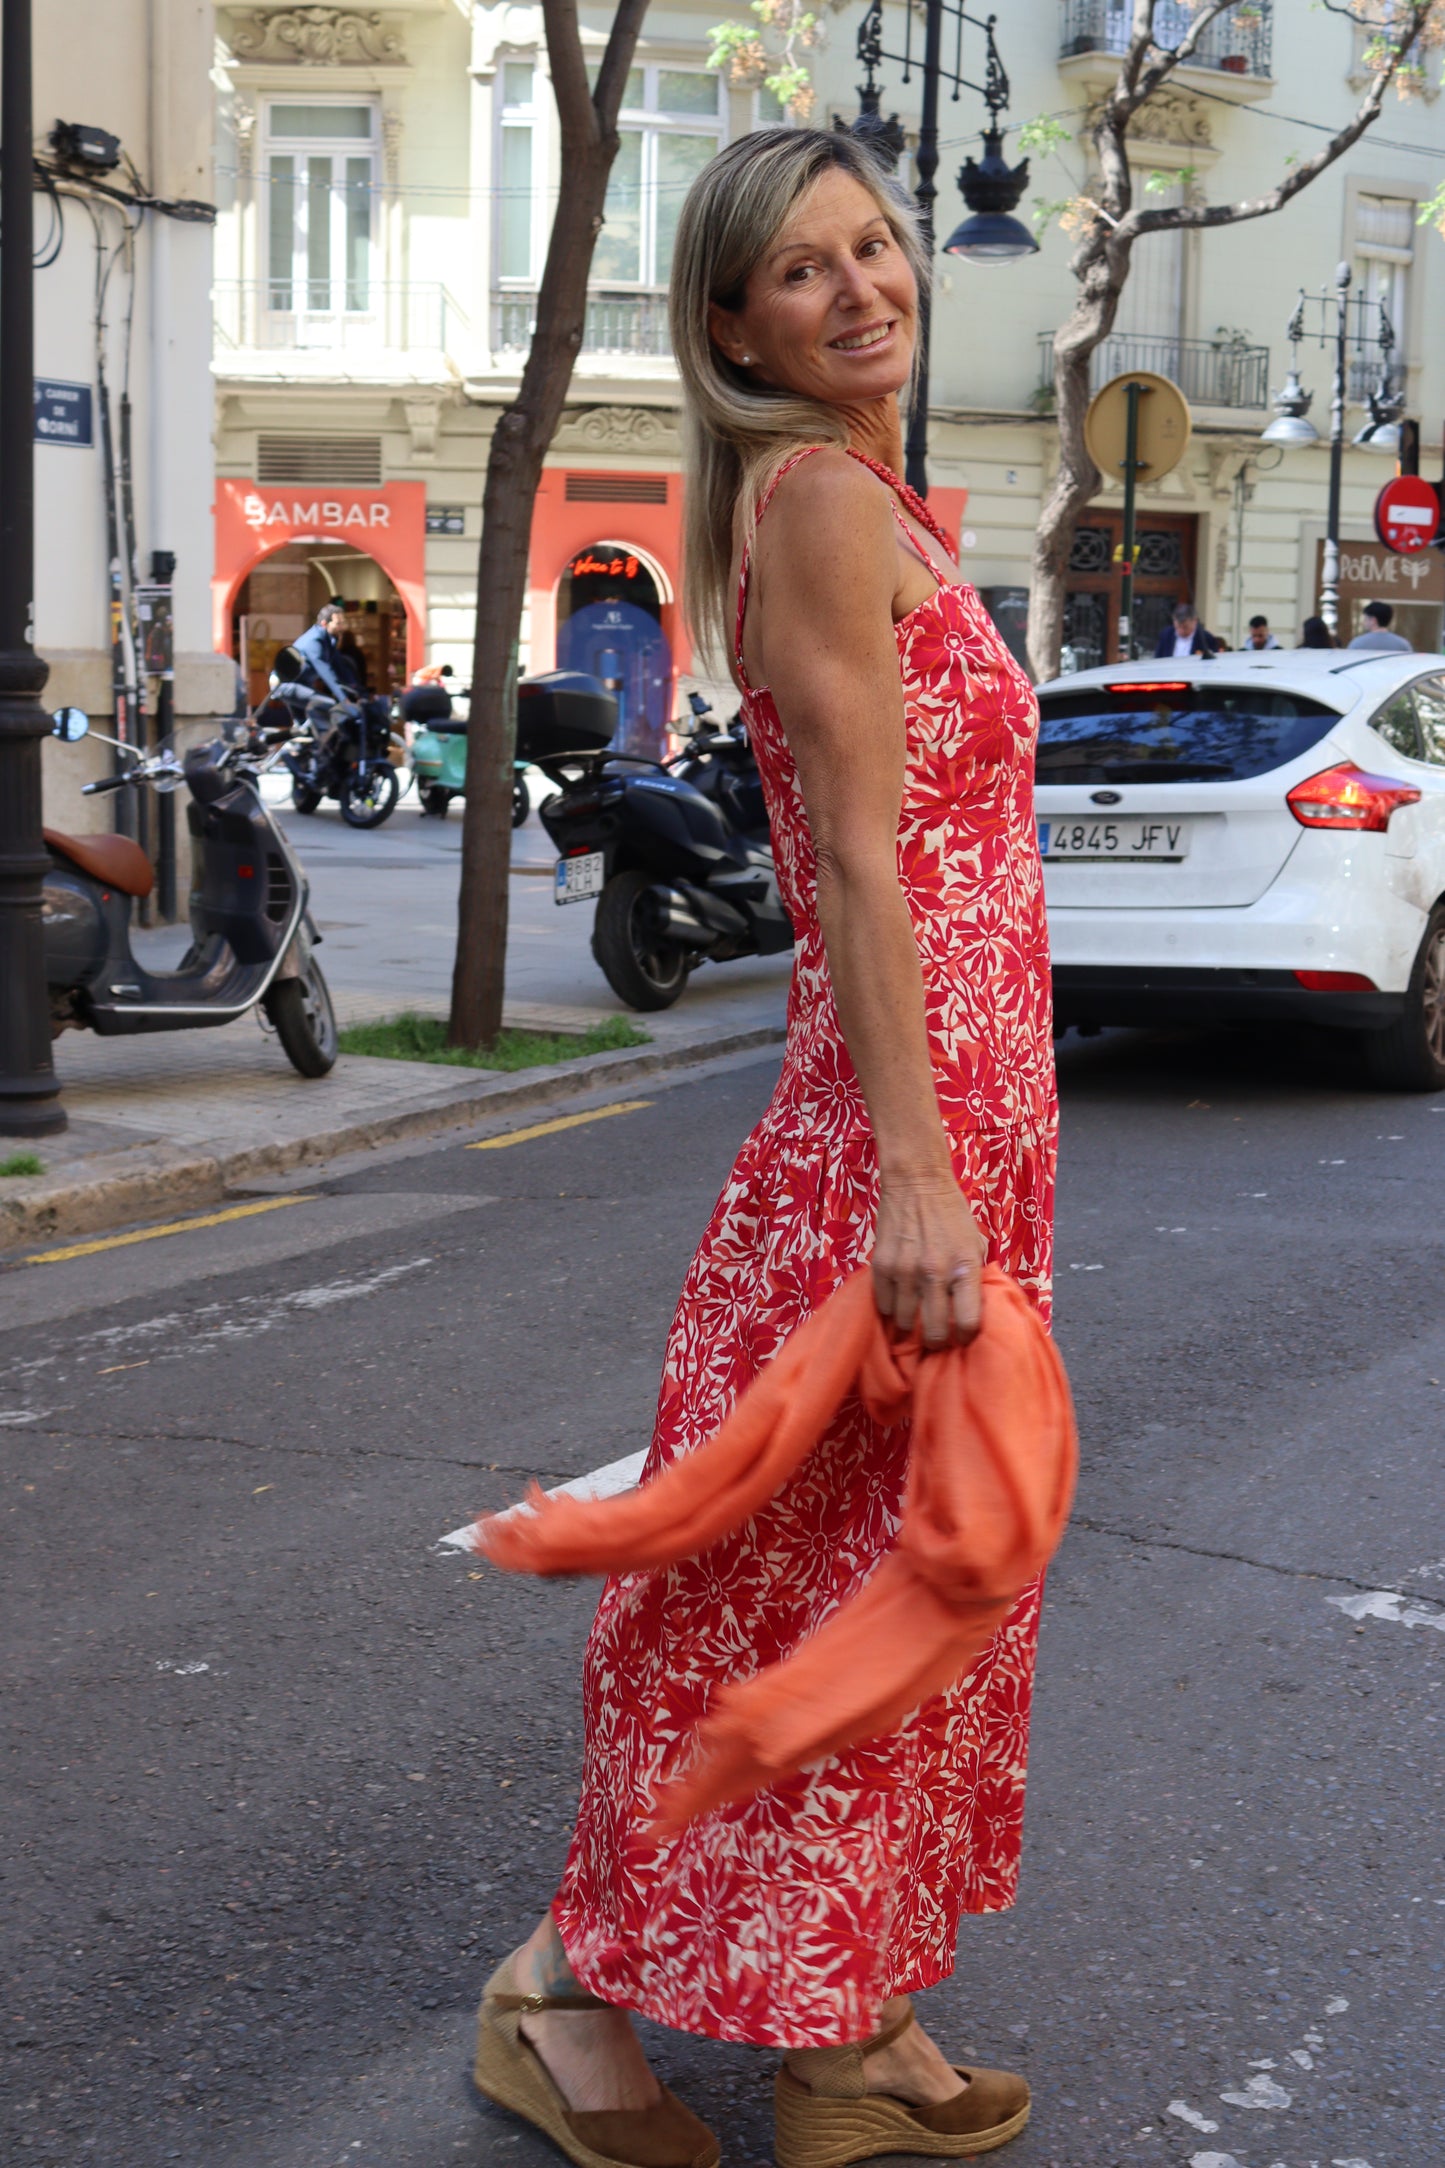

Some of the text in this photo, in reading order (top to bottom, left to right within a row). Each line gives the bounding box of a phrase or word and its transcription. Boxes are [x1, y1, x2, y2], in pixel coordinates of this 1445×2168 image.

[45, 388, 79, 401] CARRER
[244, 495, 391, 528] BAMBAR
[1053, 825, 1182, 851] 4845 JFV
[566, 855, 601, 877] 8682
[566, 874, 593, 894] KLH
